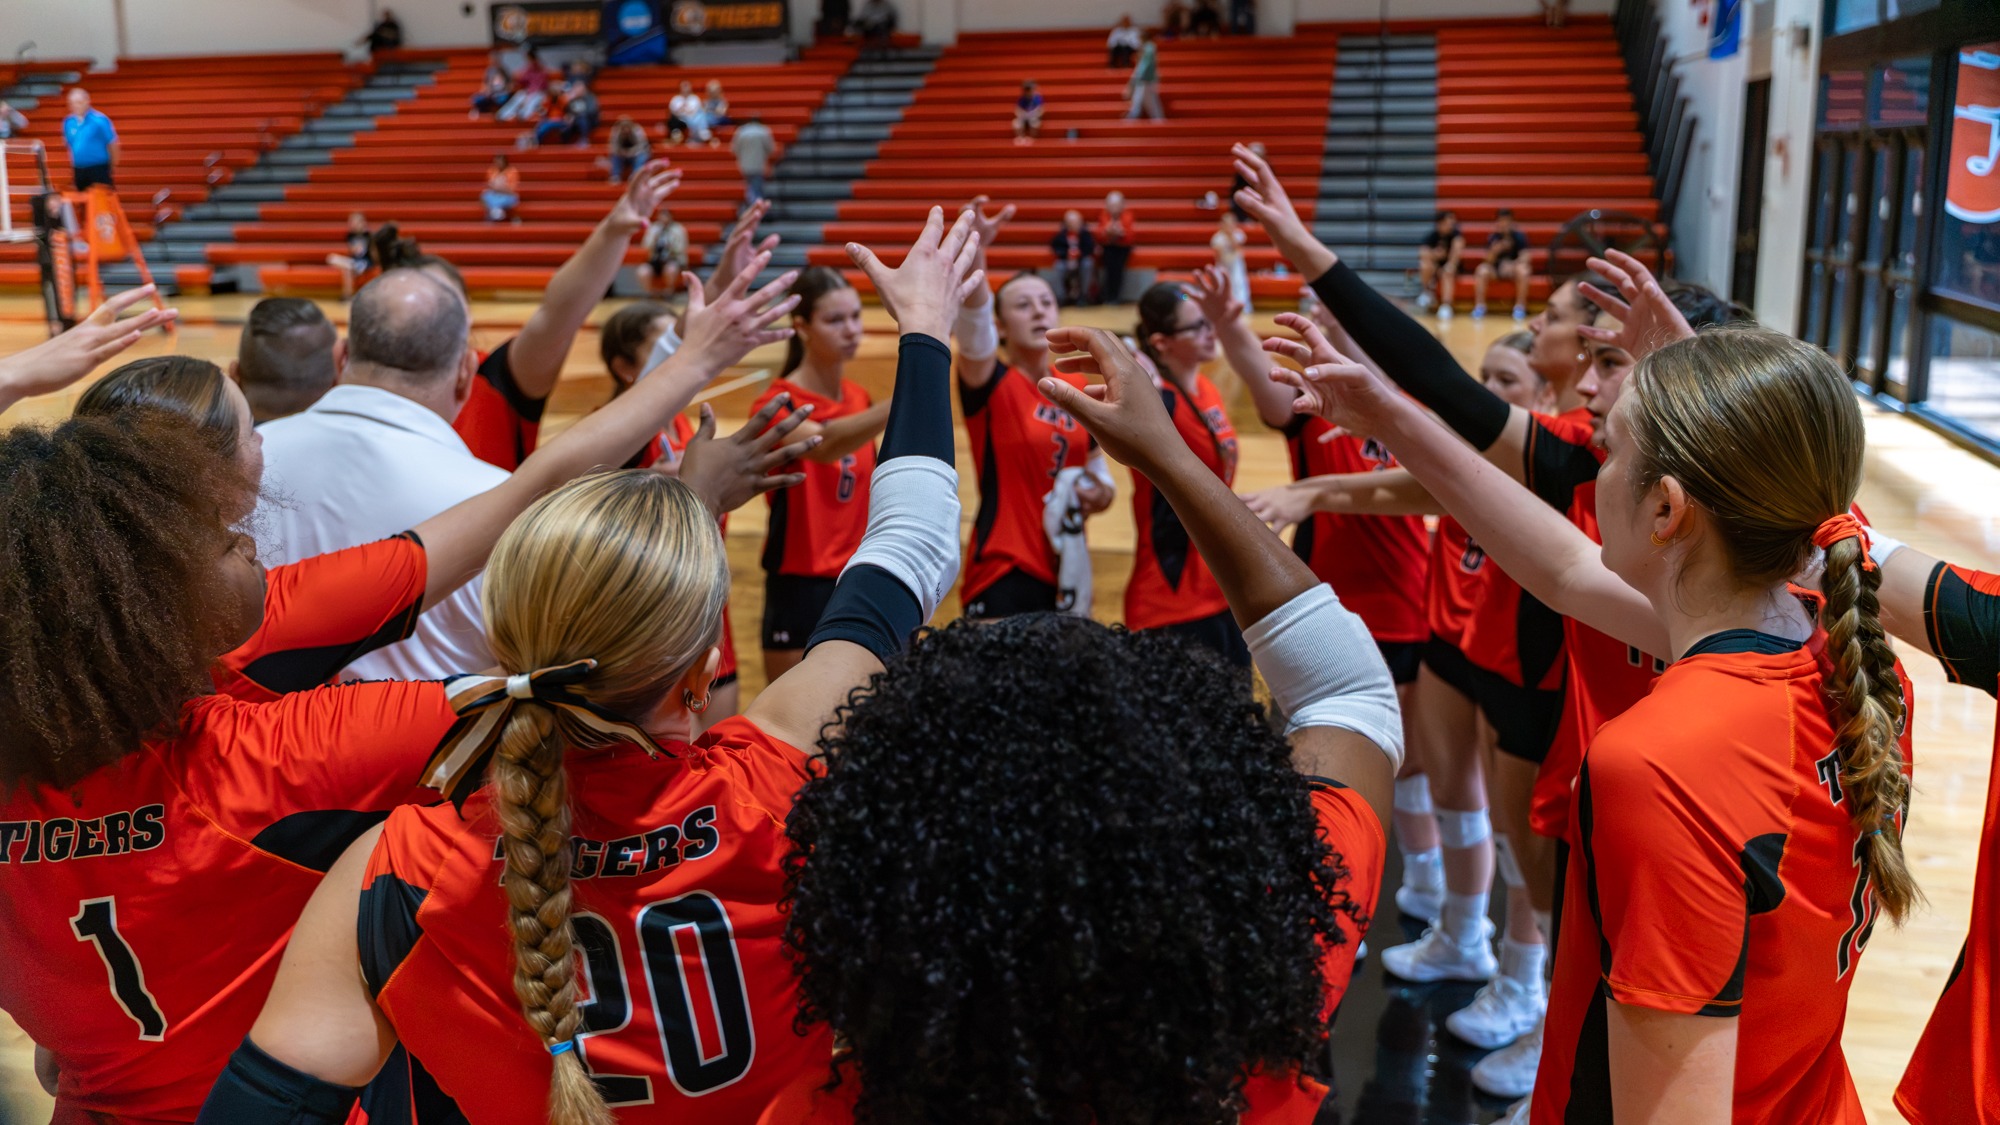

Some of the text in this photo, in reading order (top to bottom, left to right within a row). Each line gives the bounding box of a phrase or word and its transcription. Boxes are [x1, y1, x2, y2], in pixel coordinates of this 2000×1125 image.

[836, 453, 857, 503] 6
[1047, 432, 1069, 479] 3
[0, 804, 165, 864] TIGERS
[493, 805, 720, 886] GERS
[68, 895, 168, 1042] 1
[570, 889, 757, 1108] 20
